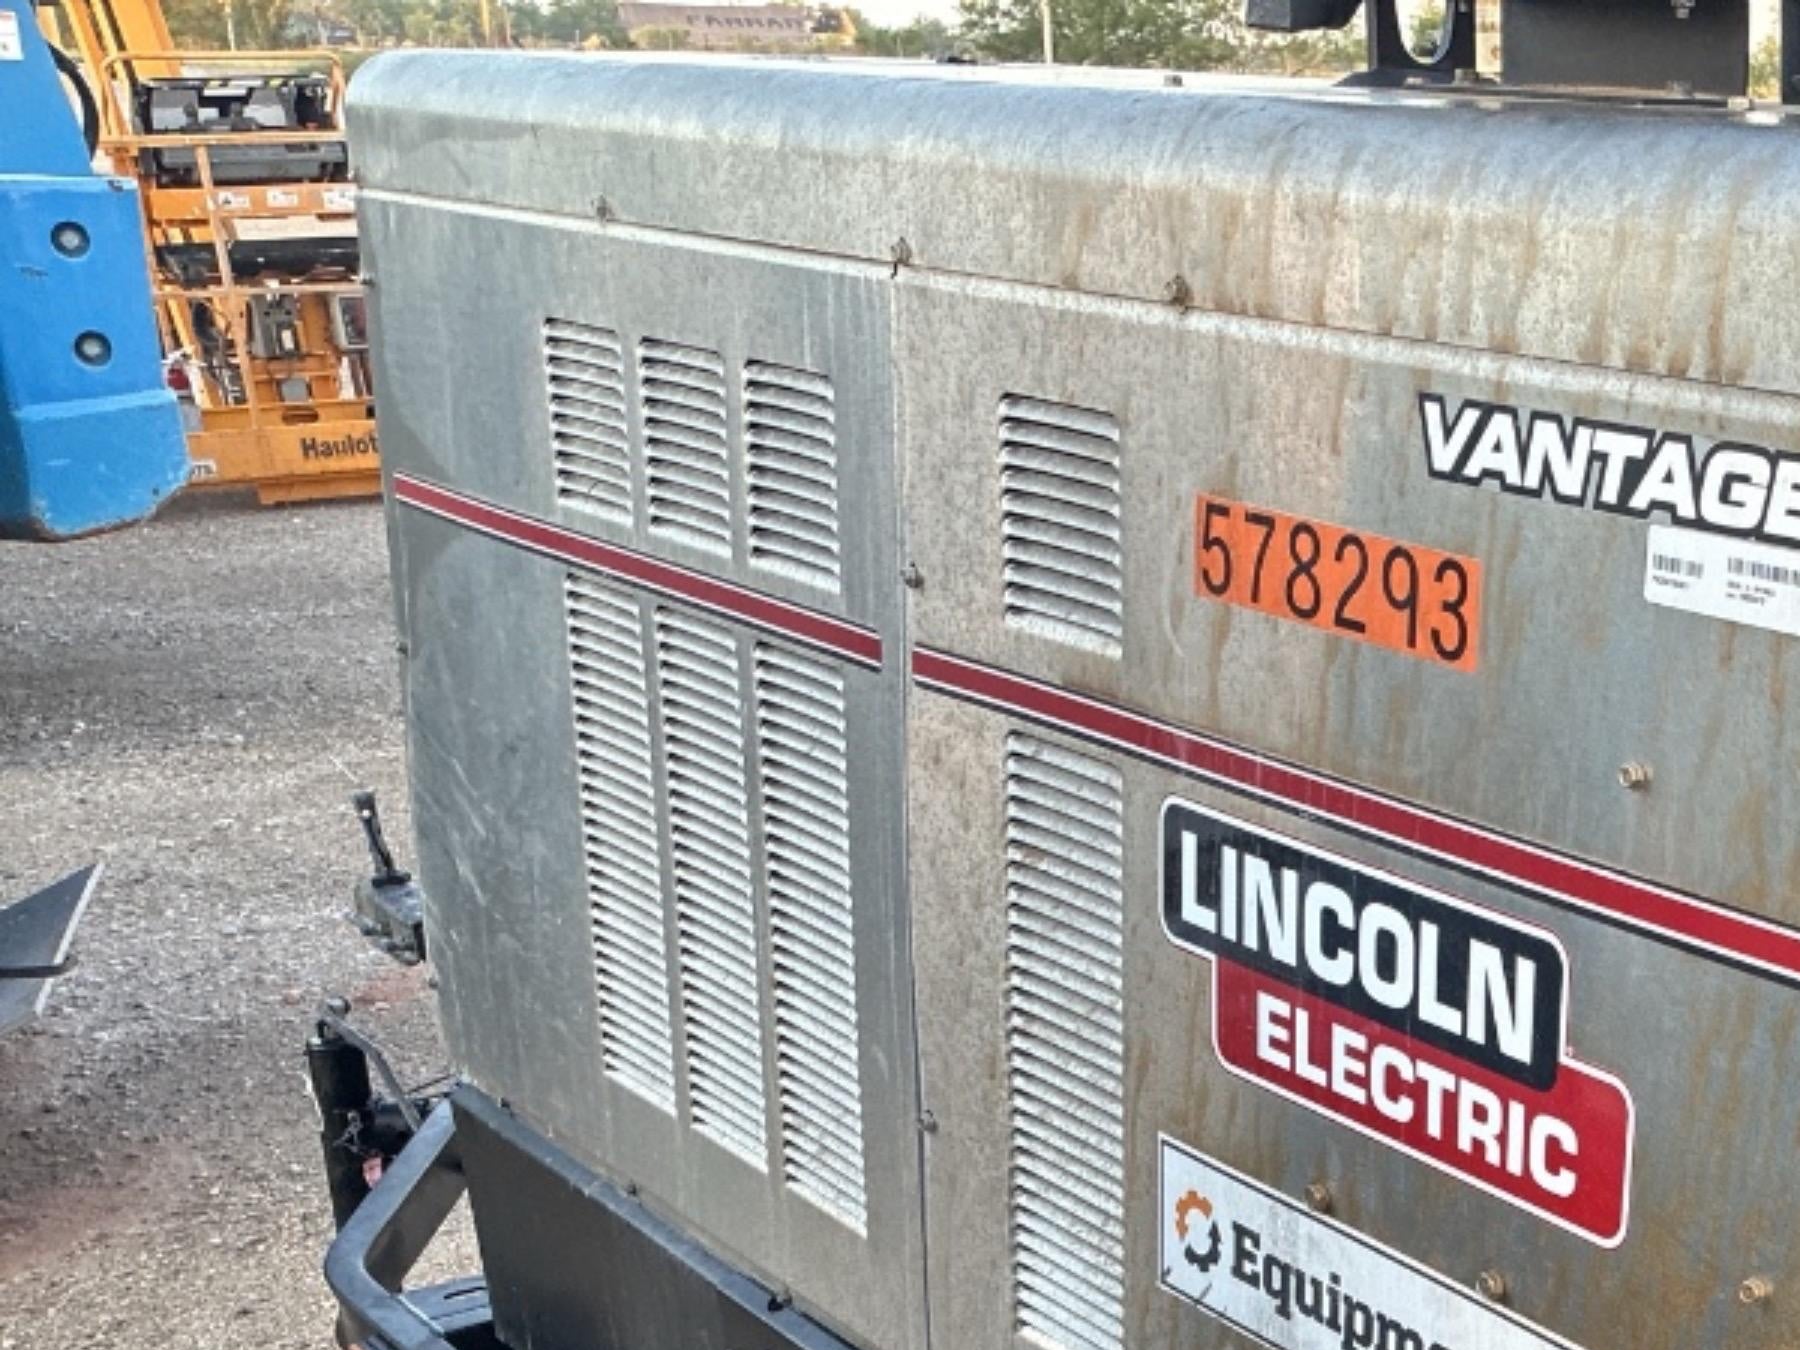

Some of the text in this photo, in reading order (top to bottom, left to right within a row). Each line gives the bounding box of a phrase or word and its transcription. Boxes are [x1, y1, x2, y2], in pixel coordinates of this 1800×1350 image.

[1200, 504, 1469, 662] 578293
[1181, 829, 1537, 1065] LINCOLN
[1256, 990, 1578, 1198] ELECTRIC
